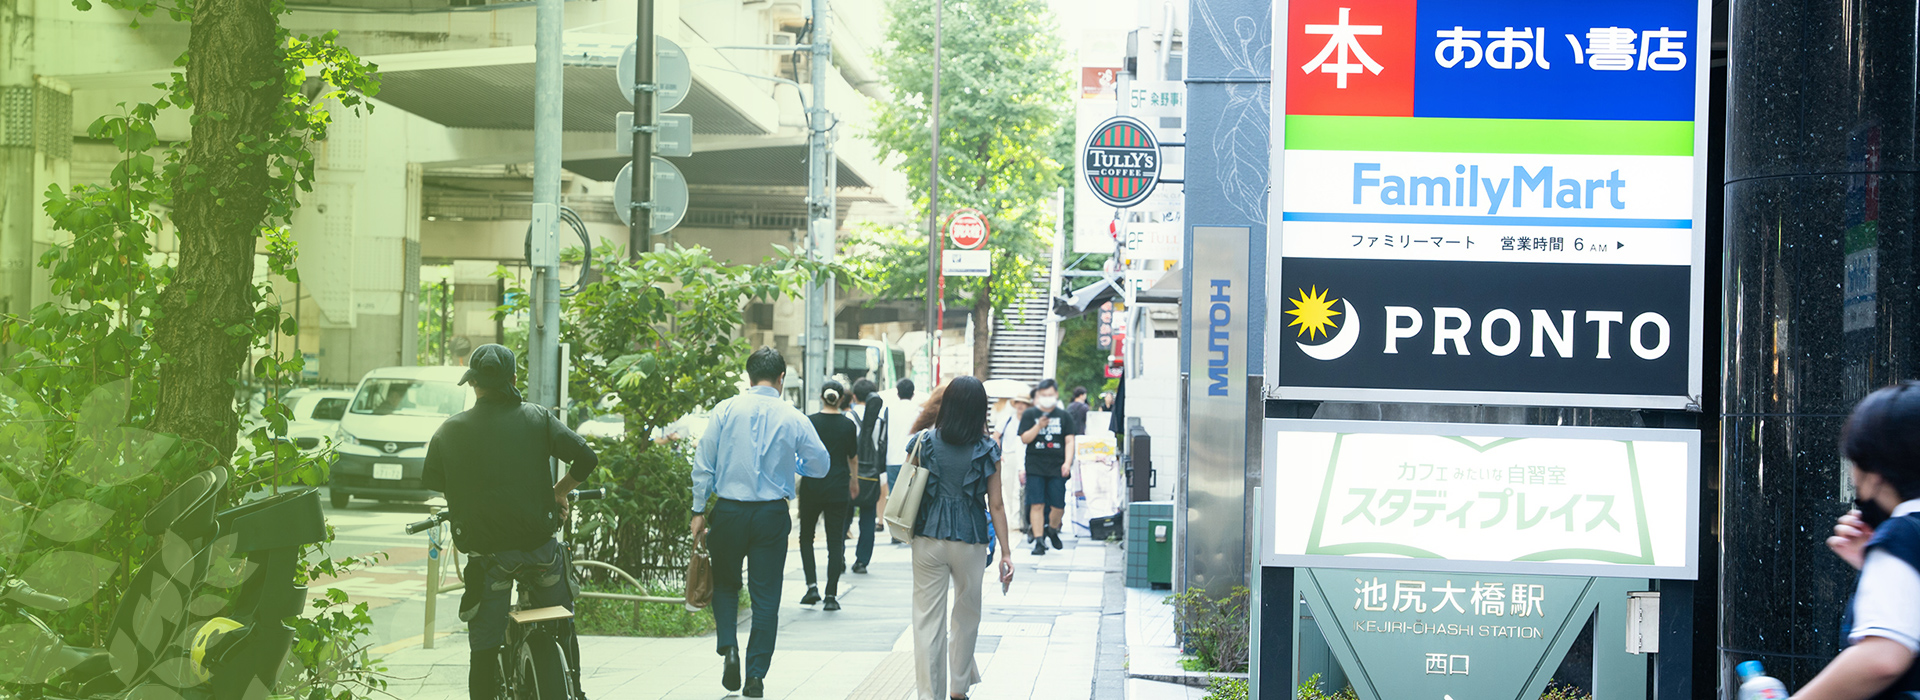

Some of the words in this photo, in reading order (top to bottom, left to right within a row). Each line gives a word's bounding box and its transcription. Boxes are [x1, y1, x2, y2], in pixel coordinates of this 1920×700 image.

[1301, 7, 1384, 89] 本
[1435, 26, 1687, 71] あおい書店
[1131, 89, 1147, 108] 5F
[1101, 168, 1142, 177] COFFEE
[1352, 163, 1626, 215] FamilyMart
[1128, 231, 1144, 251] 2F
[1352, 235, 1475, 249] ファミリーマート
[1500, 236, 1564, 252] 営業時間
[1575, 238, 1584, 251] 6
[1590, 244, 1608, 252] AM
[1209, 279, 1231, 397] MUTOH
[1384, 305, 1671, 361] PRONTO
[1398, 462, 1448, 482] カフェ
[1453, 467, 1503, 481] みたいな
[1508, 464, 1567, 486] 自習室
[1341, 487, 1621, 533] スタディプレイス
[1353, 576, 1545, 618] 池尻大橋駅
[1479, 625, 1544, 639] STATION
[1426, 652, 1470, 676] 西口
